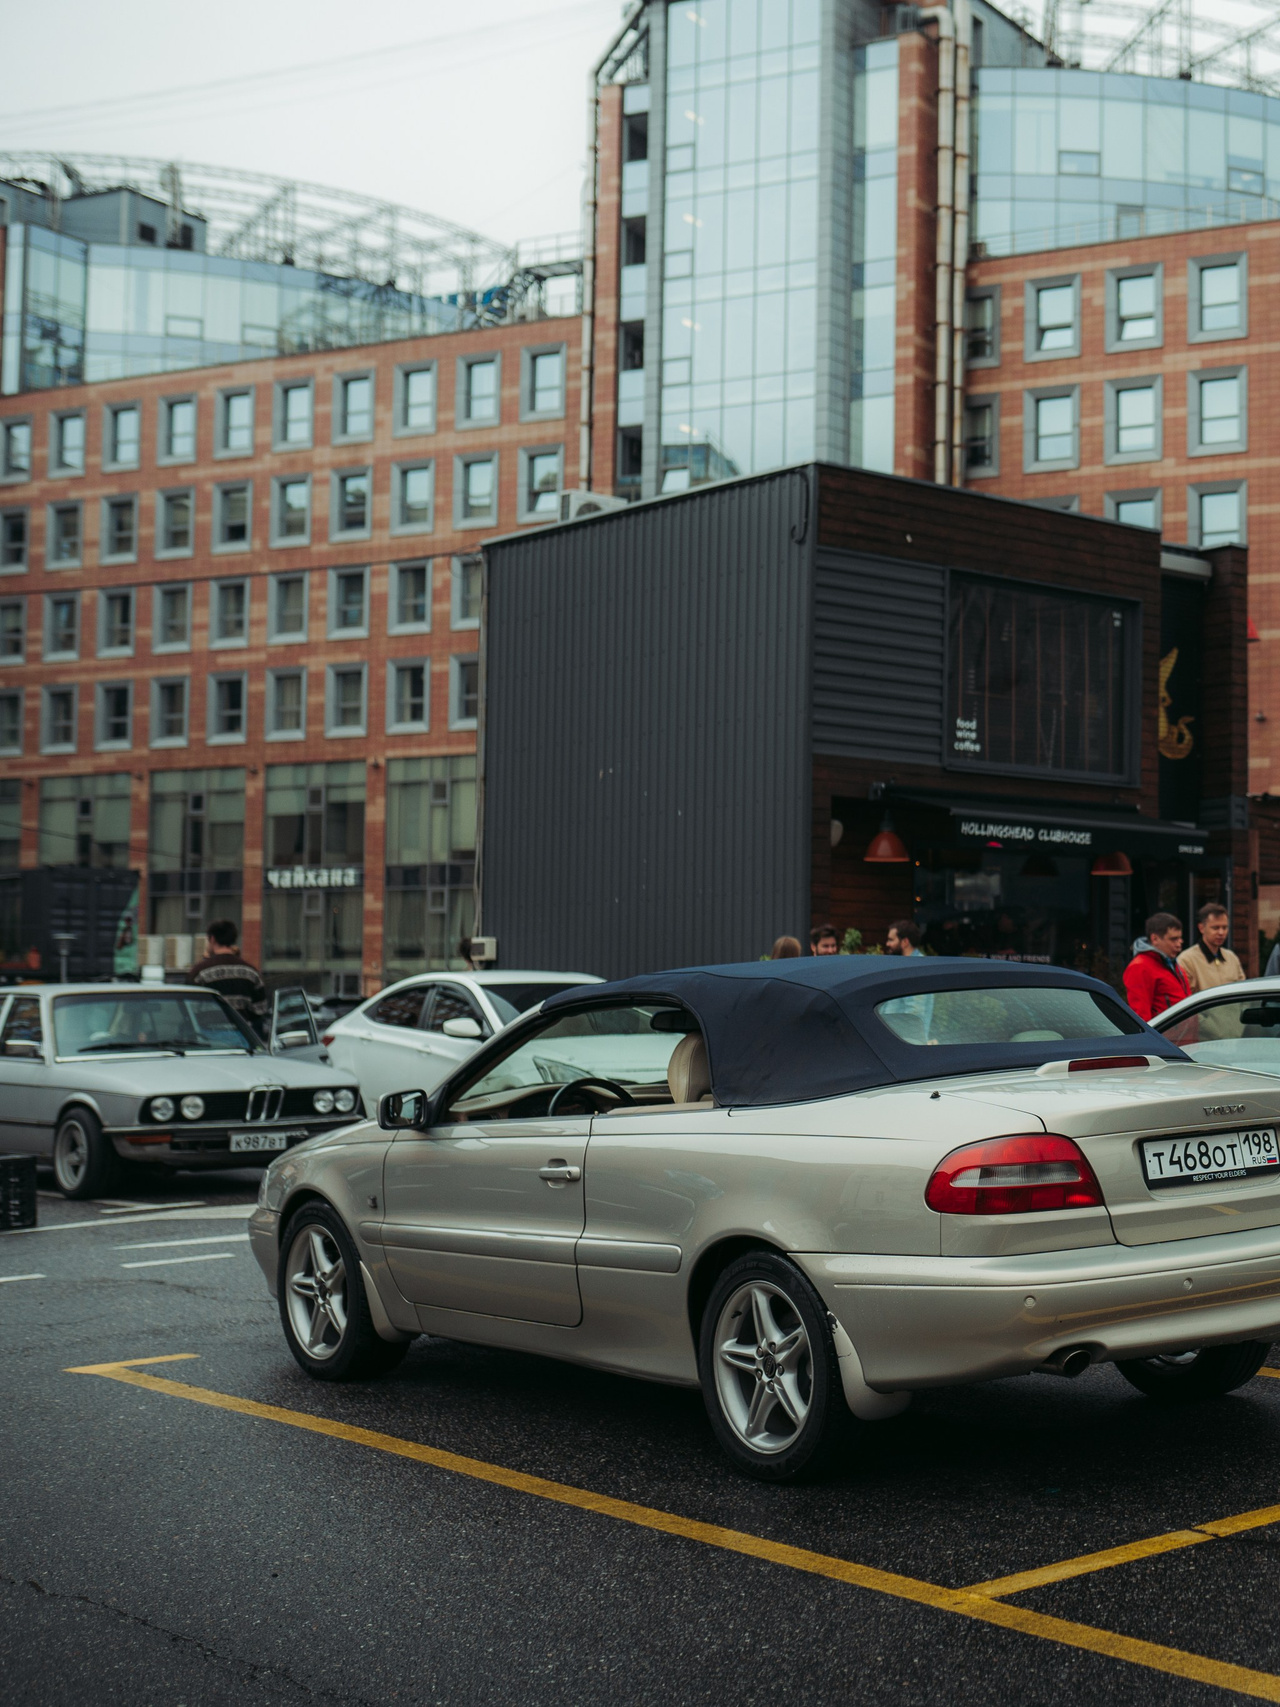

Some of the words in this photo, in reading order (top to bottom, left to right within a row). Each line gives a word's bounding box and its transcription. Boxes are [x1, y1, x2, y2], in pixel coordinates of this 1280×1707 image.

[956, 717, 977, 730] food
[956, 729, 977, 740] wine
[954, 740, 981, 752] coffee
[961, 822, 1034, 841] HOLLINGSHEAD
[1038, 829, 1092, 845] CLUBHOUSE
[1203, 1104, 1246, 1116] VOLVO
[1152, 1140, 1238, 1176] Т468ОТ
[1242, 1132, 1273, 1155] 198
[1251, 1154, 1267, 1165] RUS
[1192, 1173, 1215, 1182] RESPECT
[1214, 1171, 1229, 1180] YOUR
[1228, 1169, 1247, 1178] ELDERS
